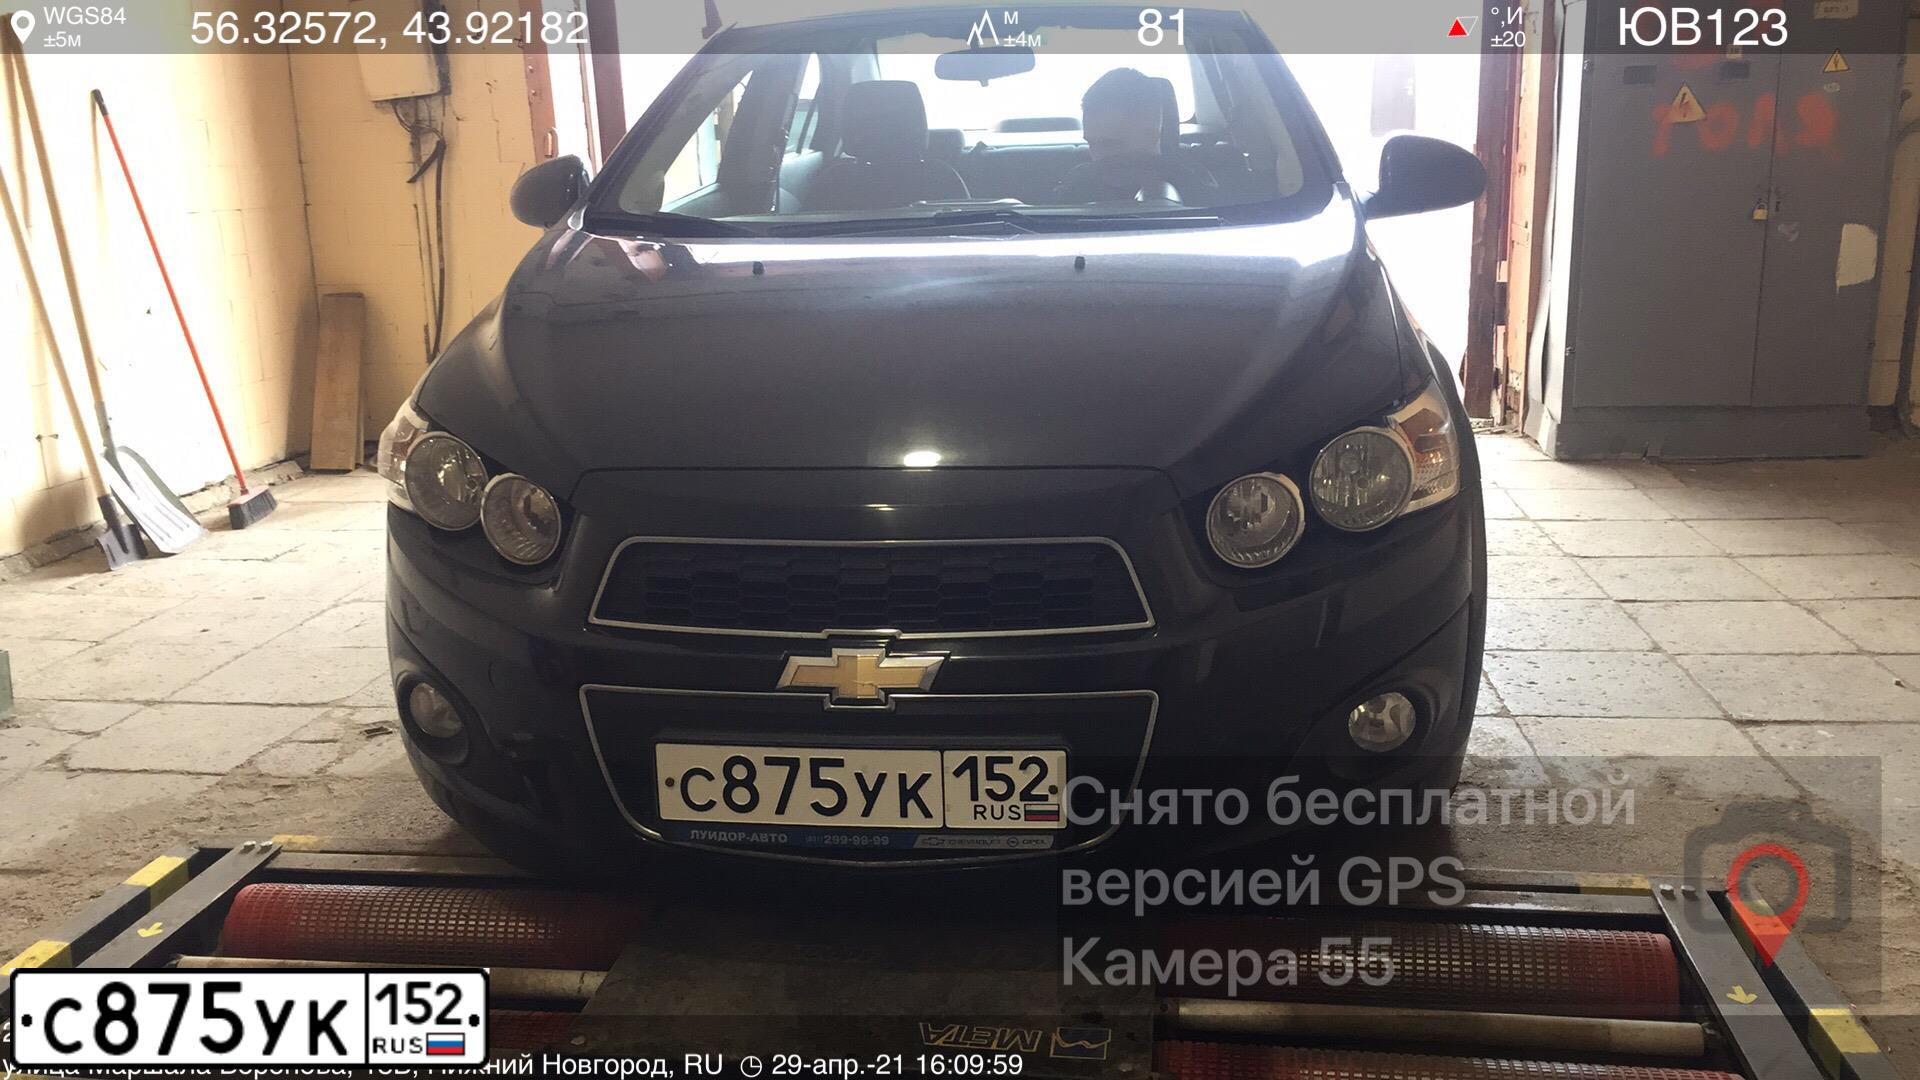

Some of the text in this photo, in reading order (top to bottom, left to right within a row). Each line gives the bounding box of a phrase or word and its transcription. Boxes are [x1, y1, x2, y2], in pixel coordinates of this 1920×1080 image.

[952, 756, 1049, 802] 152
[973, 804, 1021, 821] RUS
[690, 829, 788, 844] ЛУИДОР-АВТО
